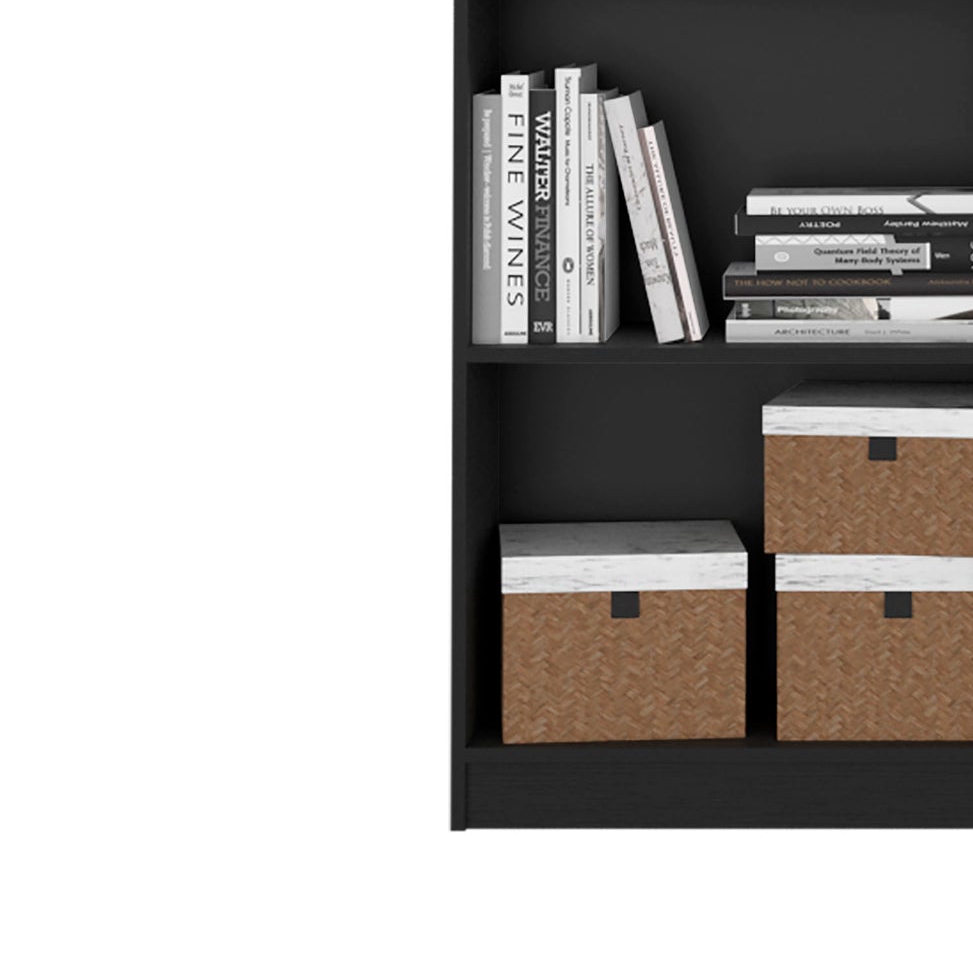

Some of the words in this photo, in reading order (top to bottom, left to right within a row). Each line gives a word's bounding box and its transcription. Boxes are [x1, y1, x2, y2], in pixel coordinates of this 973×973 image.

[507, 113, 524, 182] FINE
[534, 111, 551, 201] WALTER
[507, 198, 524, 305] WINES
[534, 203, 550, 301] FINANCE
[734, 278, 754, 286] THE
[755, 278, 783, 286] HOW
[786, 278, 809, 286] NOT
[827, 278, 891, 286] COOKBOOK
